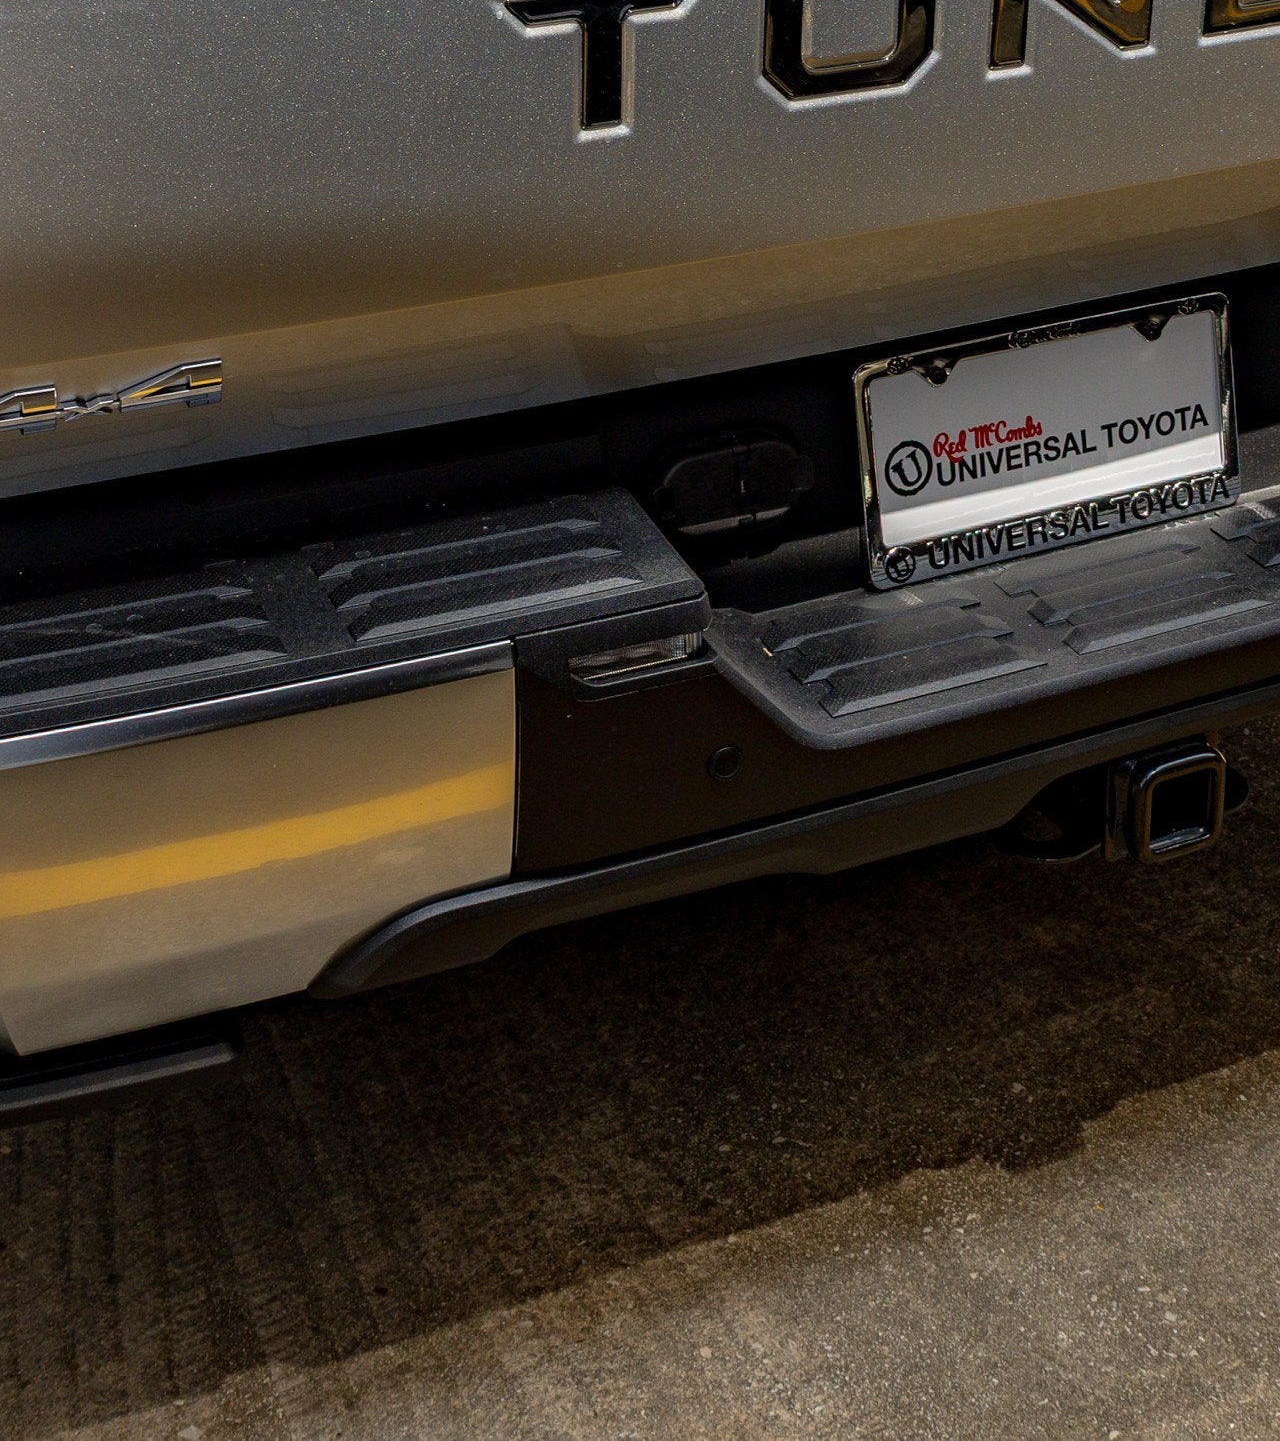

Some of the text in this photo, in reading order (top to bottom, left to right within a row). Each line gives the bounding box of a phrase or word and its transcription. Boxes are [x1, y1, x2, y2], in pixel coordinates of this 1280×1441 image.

[933, 415, 1043, 463] Red McCombs
[936, 429, 1097, 487] UNIVERSAL
[1101, 403, 1209, 448] TOYOTA
[926, 502, 1110, 570] UNIVERSAL
[1110, 473, 1230, 524] TOYOTA
